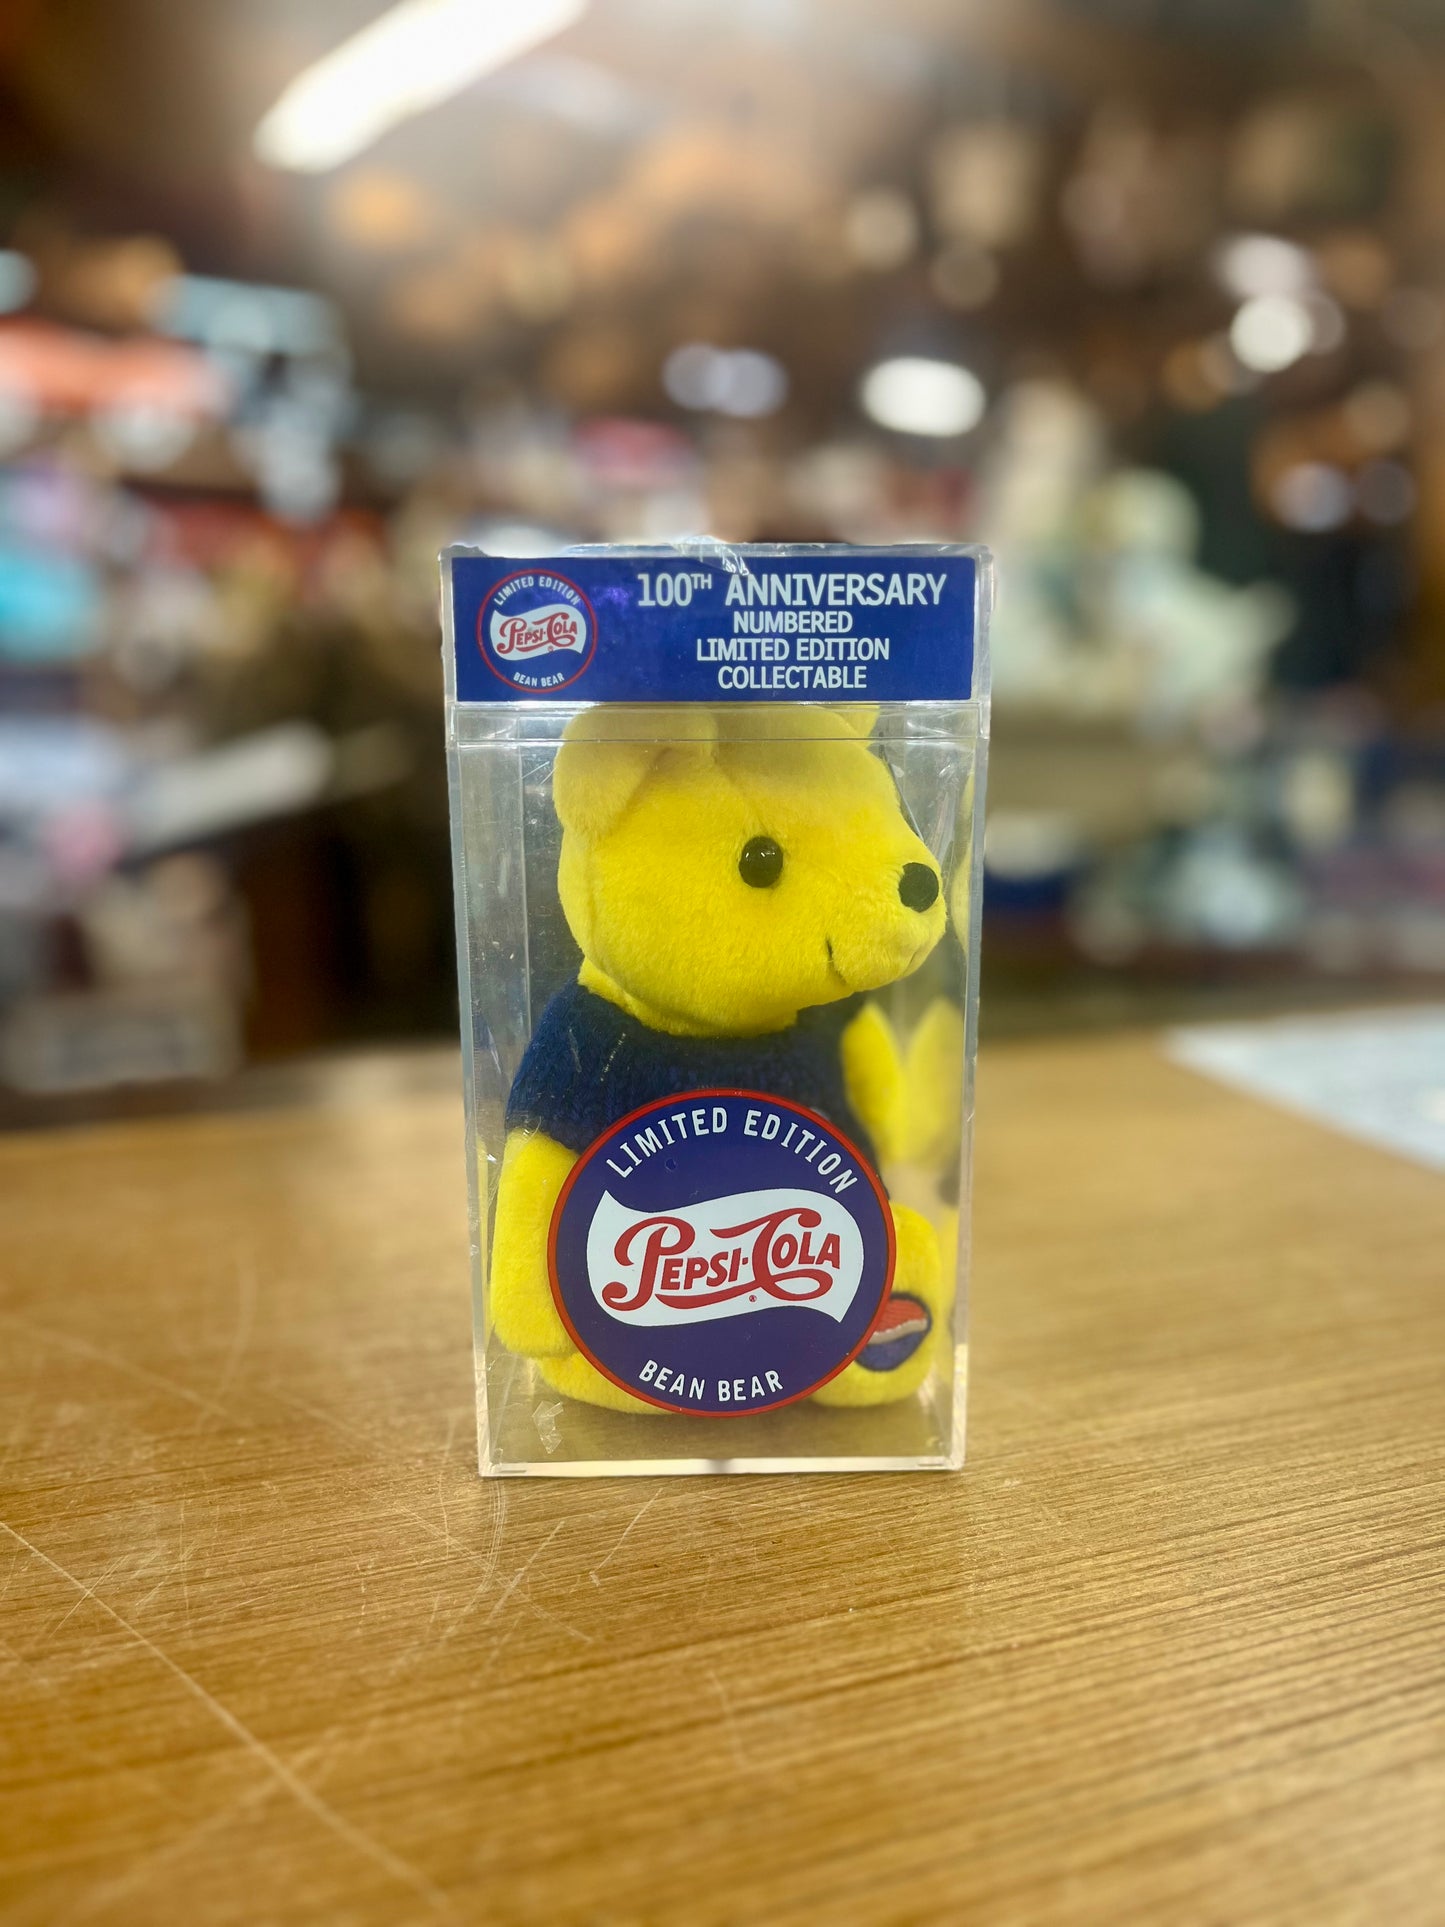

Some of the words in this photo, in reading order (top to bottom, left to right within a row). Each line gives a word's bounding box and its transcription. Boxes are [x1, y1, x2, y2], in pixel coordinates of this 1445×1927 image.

[494, 576, 534, 606] LIMITED
[538, 576, 580, 605] EDITION
[725, 573, 947, 607] ANNIVERSARY
[733, 611, 853, 634] NUMBERED
[696, 638, 790, 661] LIMITED
[797, 638, 890, 660] EDITION
[513, 672, 538, 687] BEAN
[541, 672, 564, 687] BEAR
[718, 666, 867, 689] COLLECTABLE
[606, 1107, 727, 1178] LIMITED
[744, 1109, 857, 1194] EDITION
[639, 1359, 705, 1400] BEAN
[717, 1370, 783, 1402] BEAR
